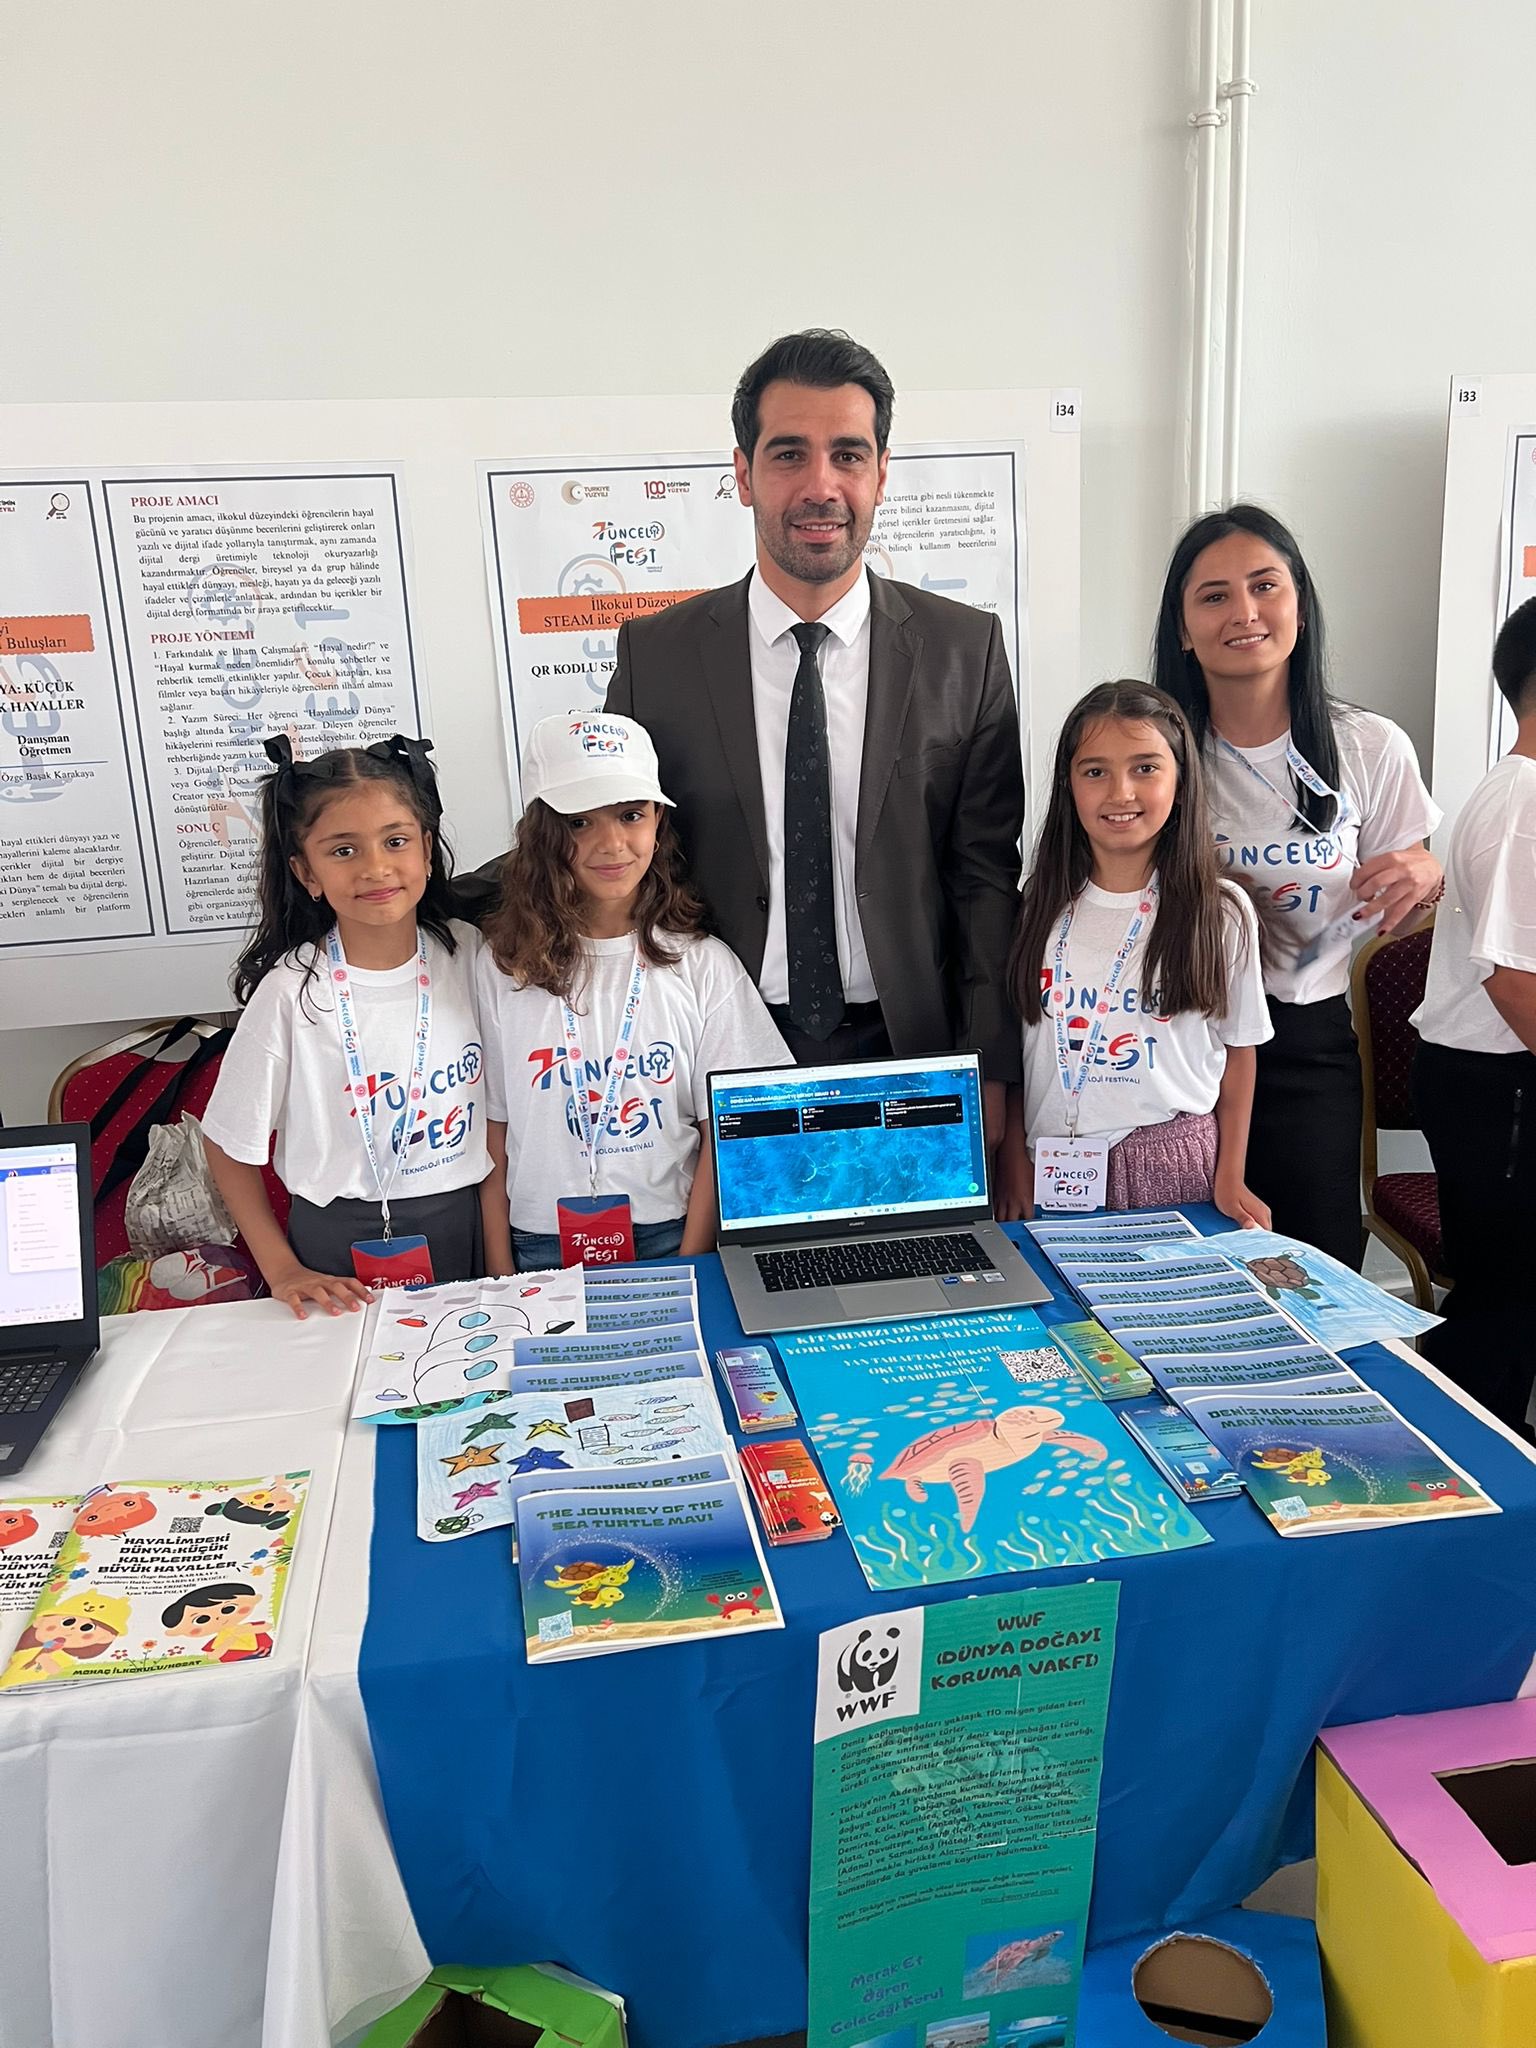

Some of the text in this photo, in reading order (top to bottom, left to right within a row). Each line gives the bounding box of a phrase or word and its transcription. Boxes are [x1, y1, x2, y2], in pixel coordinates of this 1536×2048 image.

[131, 495, 219, 507] PROJE AMACI
[133, 515, 146, 523] Bu
[148, 514, 184, 525] projenin
[218, 512, 246, 521] ilkokul
[249, 511, 299, 521] düzeyindeki
[302, 509, 350, 520] öğrencilerin
[353, 509, 374, 519] hayal
[135, 528, 166, 539] gücünü
[181, 527, 213, 537] yaratıcı
[215, 526, 253, 536] düşünme
[256, 523, 301, 533] becerilerini
[304, 522, 348, 534] geliştirerek
[351, 522, 375, 530] onları
[137, 542, 160, 552] yazılı
[174, 540, 199, 551] dijital
[202, 540, 223, 549] ifade
[267, 537, 317, 547] tanıştırmak,
[320, 538, 338, 546] aynı
[340, 536, 377, 544] zamanda
[139, 549, 378, 566] dijital dergi üretimiyle teknoloji okuryazarlığı
[610, 542, 656, 566] FEST
[591, 596, 632, 611] İlkokul
[544, 614, 593, 628] STEAM
[598, 613, 611, 625] ile
[7, 637, 67, 651] Buluşları
[151, 628, 254, 644] PROJE YÖNTEMİ
[165, 649, 214, 658] Farkındalık
[531, 665, 550, 677] QR
[554, 663, 598, 674] KODLU
[24, 680, 75, 694] KÜÇÜK
[11, 699, 85, 712] HAYALLER
[17, 734, 70, 746] Danışman
[582, 735, 624, 753] FEST
[19, 745, 72, 758] Öğretmen
[2, 770, 95, 783] Özge Başak Karakaya
[176, 822, 221, 833] SONUÇ
[1, 838, 23, 847] hayal
[59, 835, 90, 844] dünyayı
[97, 903, 130, 913] platform
[1105, 1076, 1140, 1084] FESTİVALİ
[580, 1141, 653, 1157] TENOLOJİ FESTİVALİ
[401, 1160, 440, 1176] TEKNOLOJİ
[1054, 1180, 1089, 1196] FEST
[584, 1246, 618, 1262] FEST
[796, 1313, 1017, 1344] KİTABIMIZI DİNLEDİYSENİZ
[562, 1342, 630, 1352] JOURNEY
[653, 1335, 683, 1344] THE
[785, 1337, 919, 1356] YORUMLARINIZI
[574, 1350, 633, 1361] TURTLE
[1163, 1352, 1331, 1374] DENİZ KAPLUMBAĞASI
[1249, 1362, 1338, 1381] YOLCULUĞU
[1207, 1404, 1388, 1418] DENİZ KAPLUMBAĞASI
[1299, 1412, 1394, 1428] YOLCULUĞU
[536, 1499, 724, 1520] THE JOURNEY OF THE
[551, 1513, 714, 1531] SEA TURTLE MAVI
[124, 1533, 231, 1544] HAYALİMDEKİ
[120, 1544, 229, 1555] DÜNYA:KÜÇÜK
[118, 1553, 224, 1563] KALPLERDEN
[98, 1561, 237, 1573] BÜYÜK HAYALLER
[997, 1611, 1046, 1632] WWF
[936, 1627, 1101, 1666] (DÜNYA DOĞAYI
[73, 1666, 112, 1676] MOHAÇ
[931, 1654, 1099, 1690] KORUMA VAKFI)
[837, 1691, 896, 1722] WWF
[851, 1955, 924, 1989] Merak Et
[863, 1981, 910, 2004] Öğren
[830, 2004, 901, 2034] Geleceği
